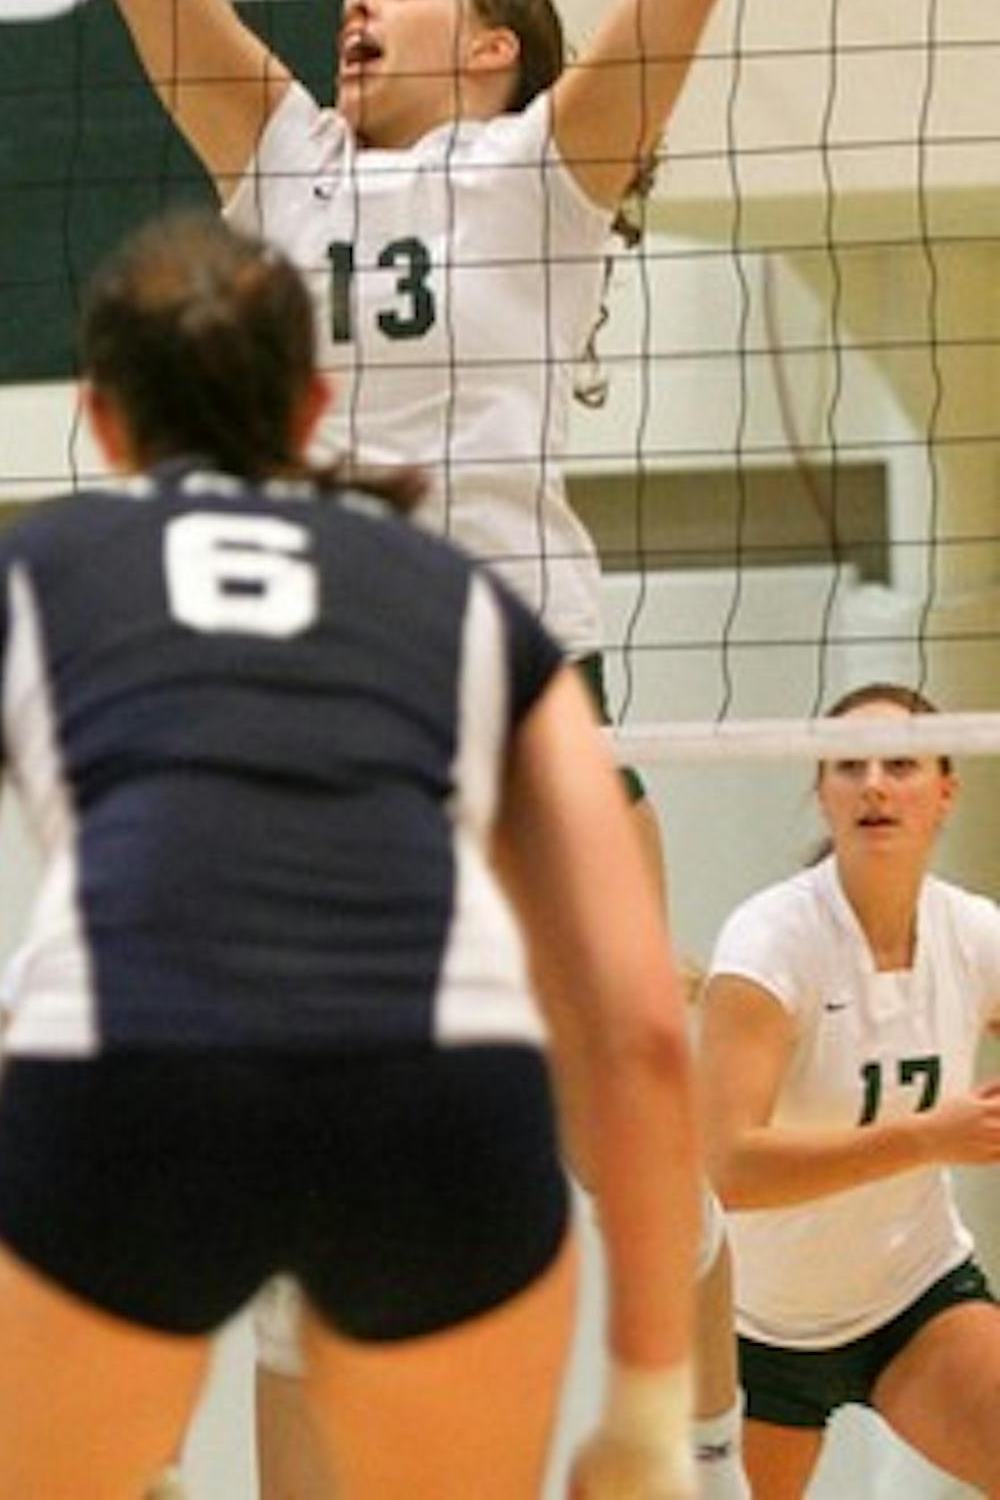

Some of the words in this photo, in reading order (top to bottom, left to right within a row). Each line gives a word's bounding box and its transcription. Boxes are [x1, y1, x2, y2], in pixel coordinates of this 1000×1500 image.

[328, 237, 436, 344] 13
[164, 511, 320, 640] 6
[857, 1055, 942, 1127] 17
